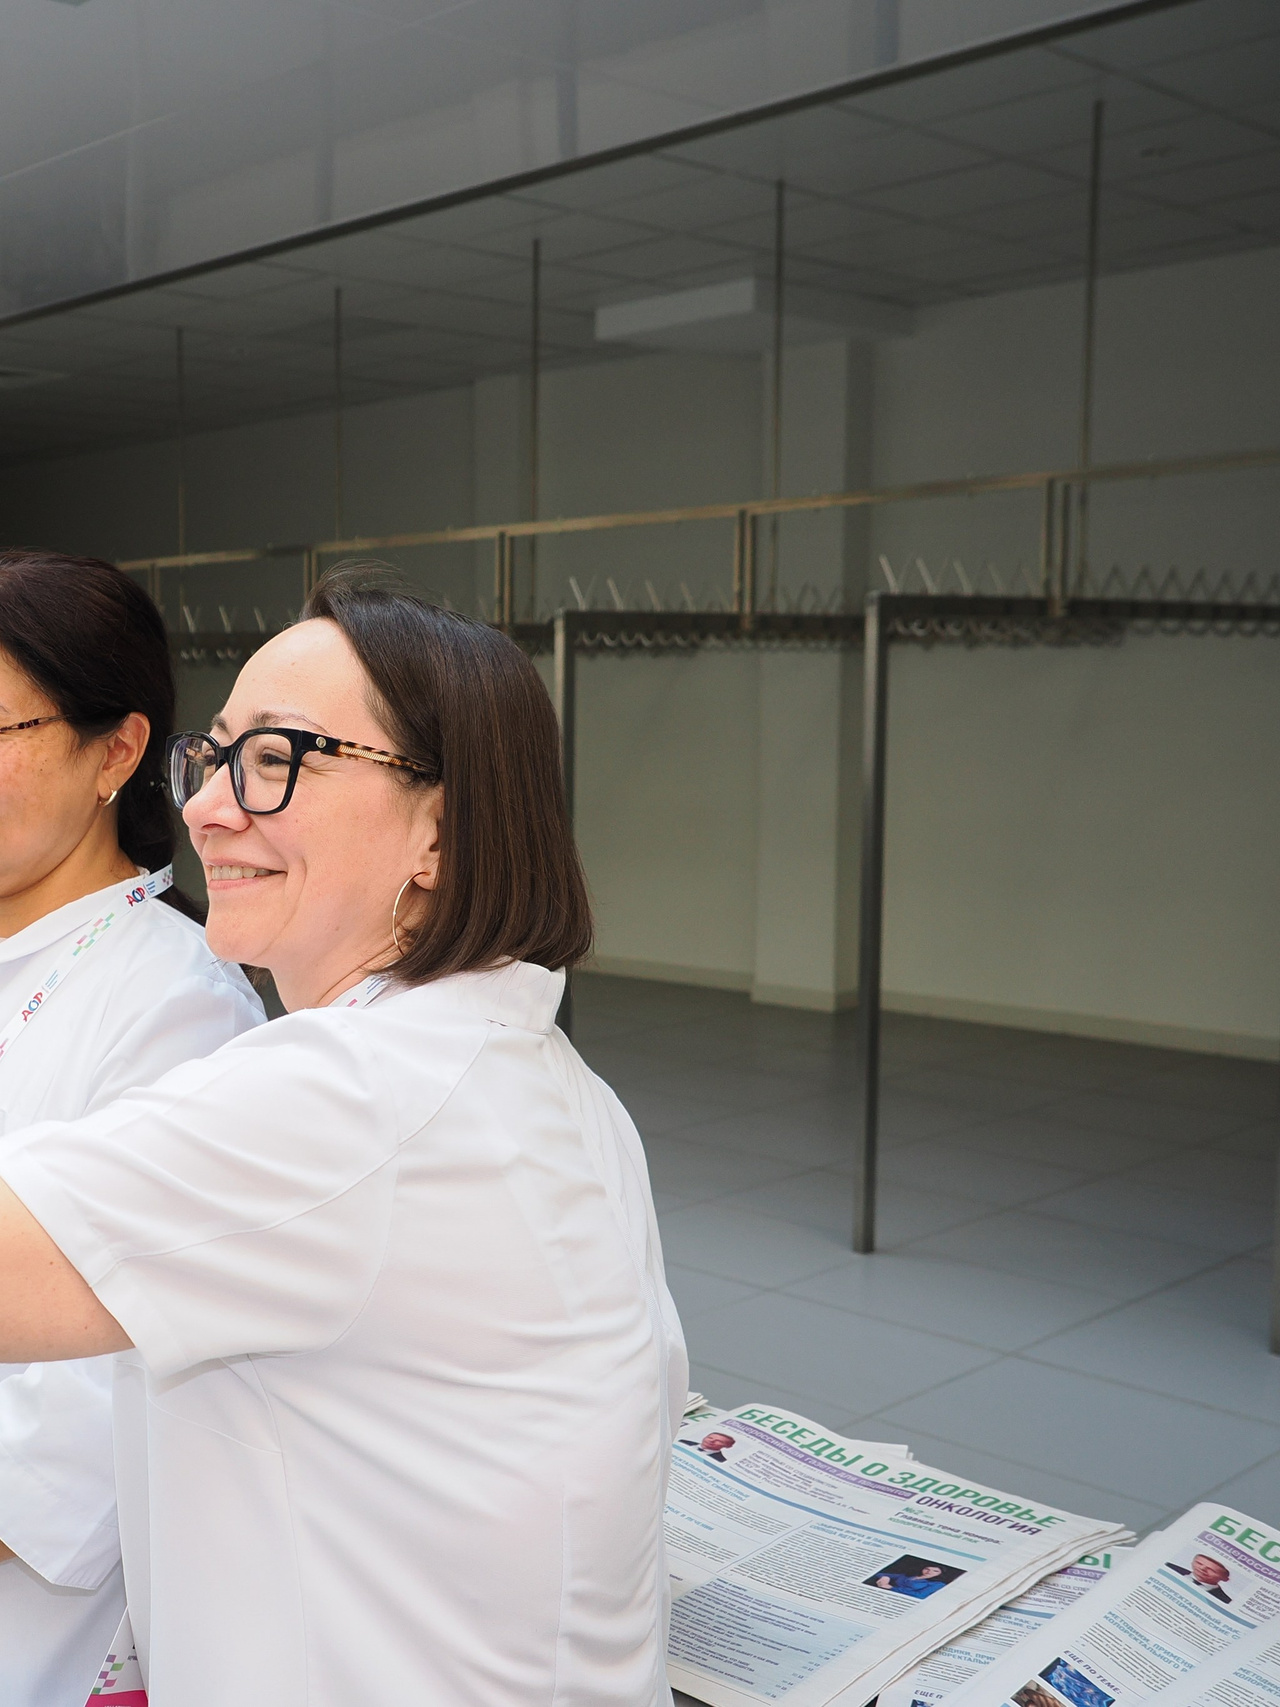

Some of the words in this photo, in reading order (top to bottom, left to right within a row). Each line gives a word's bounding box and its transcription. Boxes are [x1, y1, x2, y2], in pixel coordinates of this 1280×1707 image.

[735, 1408, 864, 1468] БЕСЕДЫ
[860, 1462, 889, 1477] О
[888, 1471, 1066, 1529] ЗДОРОВЬЕ
[804, 1457, 837, 1475] газета
[836, 1471, 858, 1484] для
[894, 1511, 935, 1526] Главная
[916, 1496, 1043, 1536] ОНКОЛОГИЯ
[1148, 1576, 1222, 1625] КОЛОРЕКТАЛЬНЫЙ
[1151, 1583, 1232, 1636] НЕСПЕЦИФИЧЕСКИЕ
[1102, 1615, 1180, 1669] КОЛОРЕКТАЛЬНОГО
[1152, 1643, 1196, 1670] ПРИМЕНЯ
[1063, 1650, 1084, 1665] ЕЩЕ
[1083, 1664, 1097, 1675] ПО
[914, 1689, 934, 1698] ЕЩЕ
